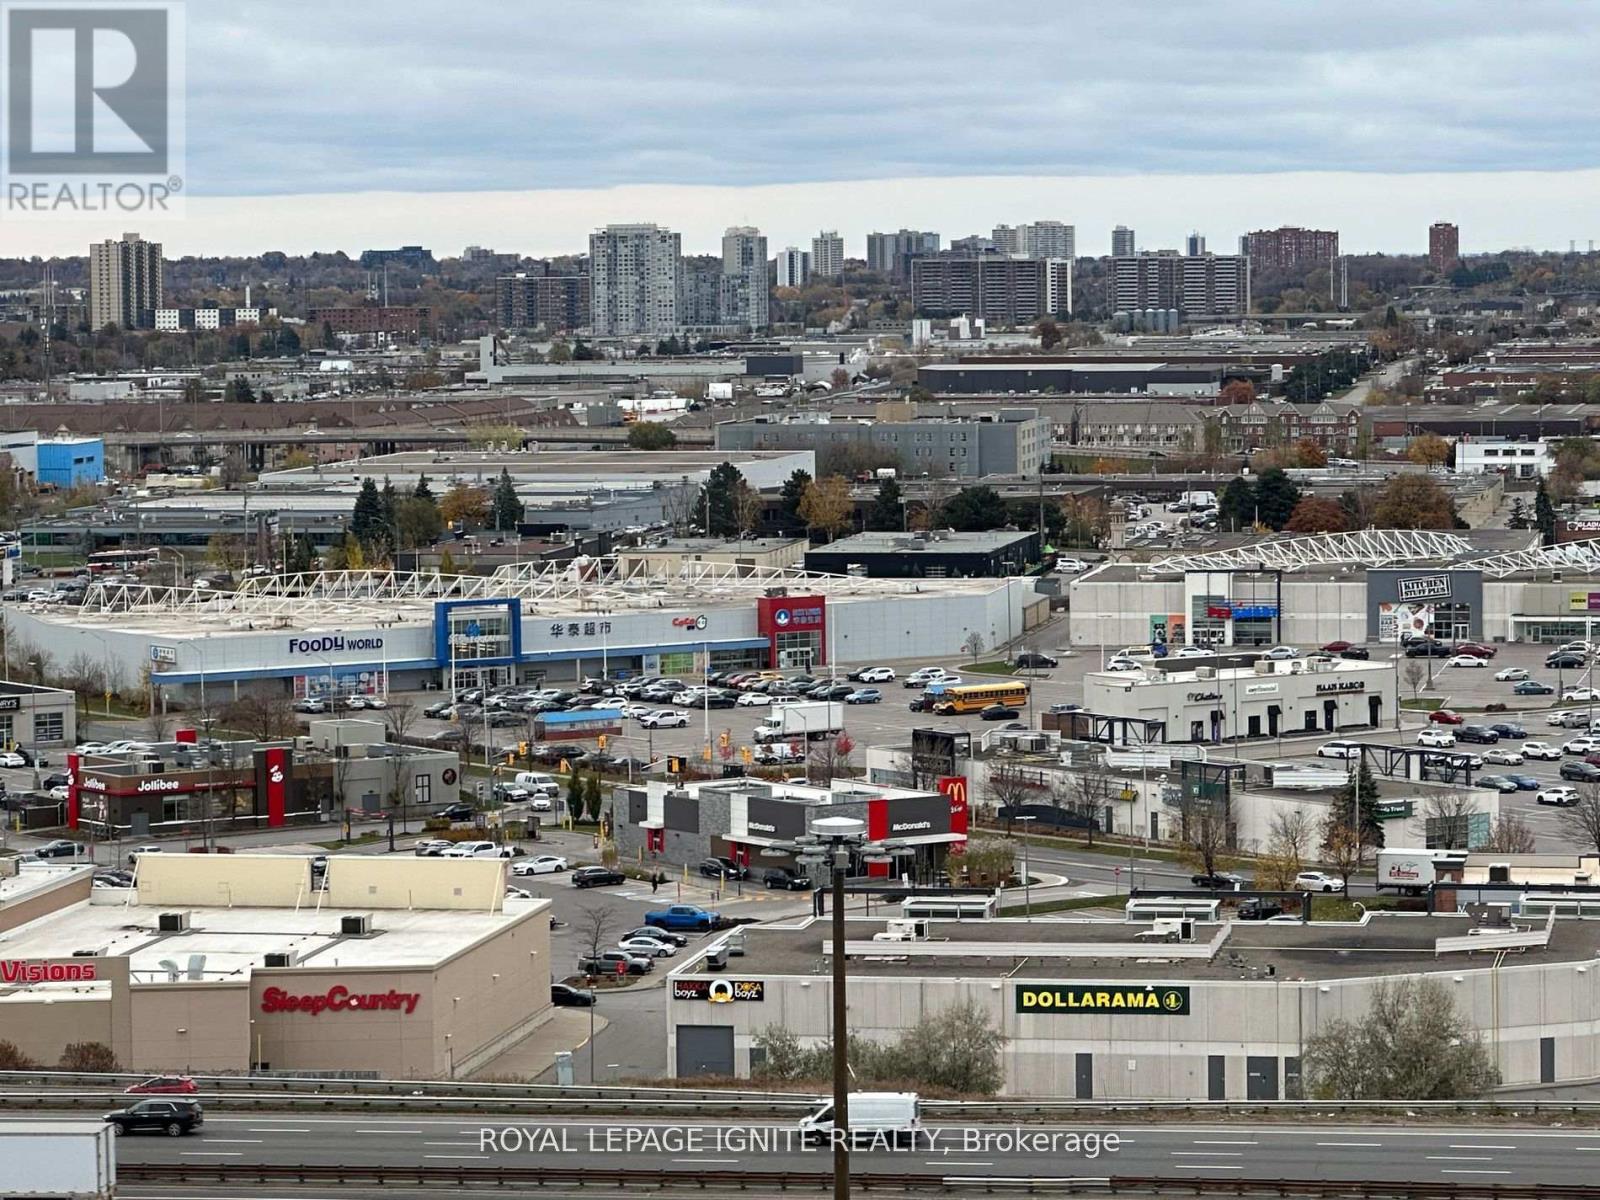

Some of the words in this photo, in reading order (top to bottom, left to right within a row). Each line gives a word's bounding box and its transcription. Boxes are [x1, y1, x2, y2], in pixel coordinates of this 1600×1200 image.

[1404, 579, 1445, 590] KITCHEN
[1404, 588, 1427, 597] STUFF
[1428, 586, 1446, 595] PLUS
[550, 621, 612, 638] 华泰超市
[347, 638, 383, 651] WORLD
[83, 776, 106, 791] Jollibee
[137, 779, 180, 792] Jollibee
[748, 821, 776, 833] McDonald's
[892, 821, 930, 832] McDonald's
[0, 960, 96, 983] Visions
[735, 982, 762, 991] DOSA
[1023, 991, 1160, 1008] DOLLARAMA
